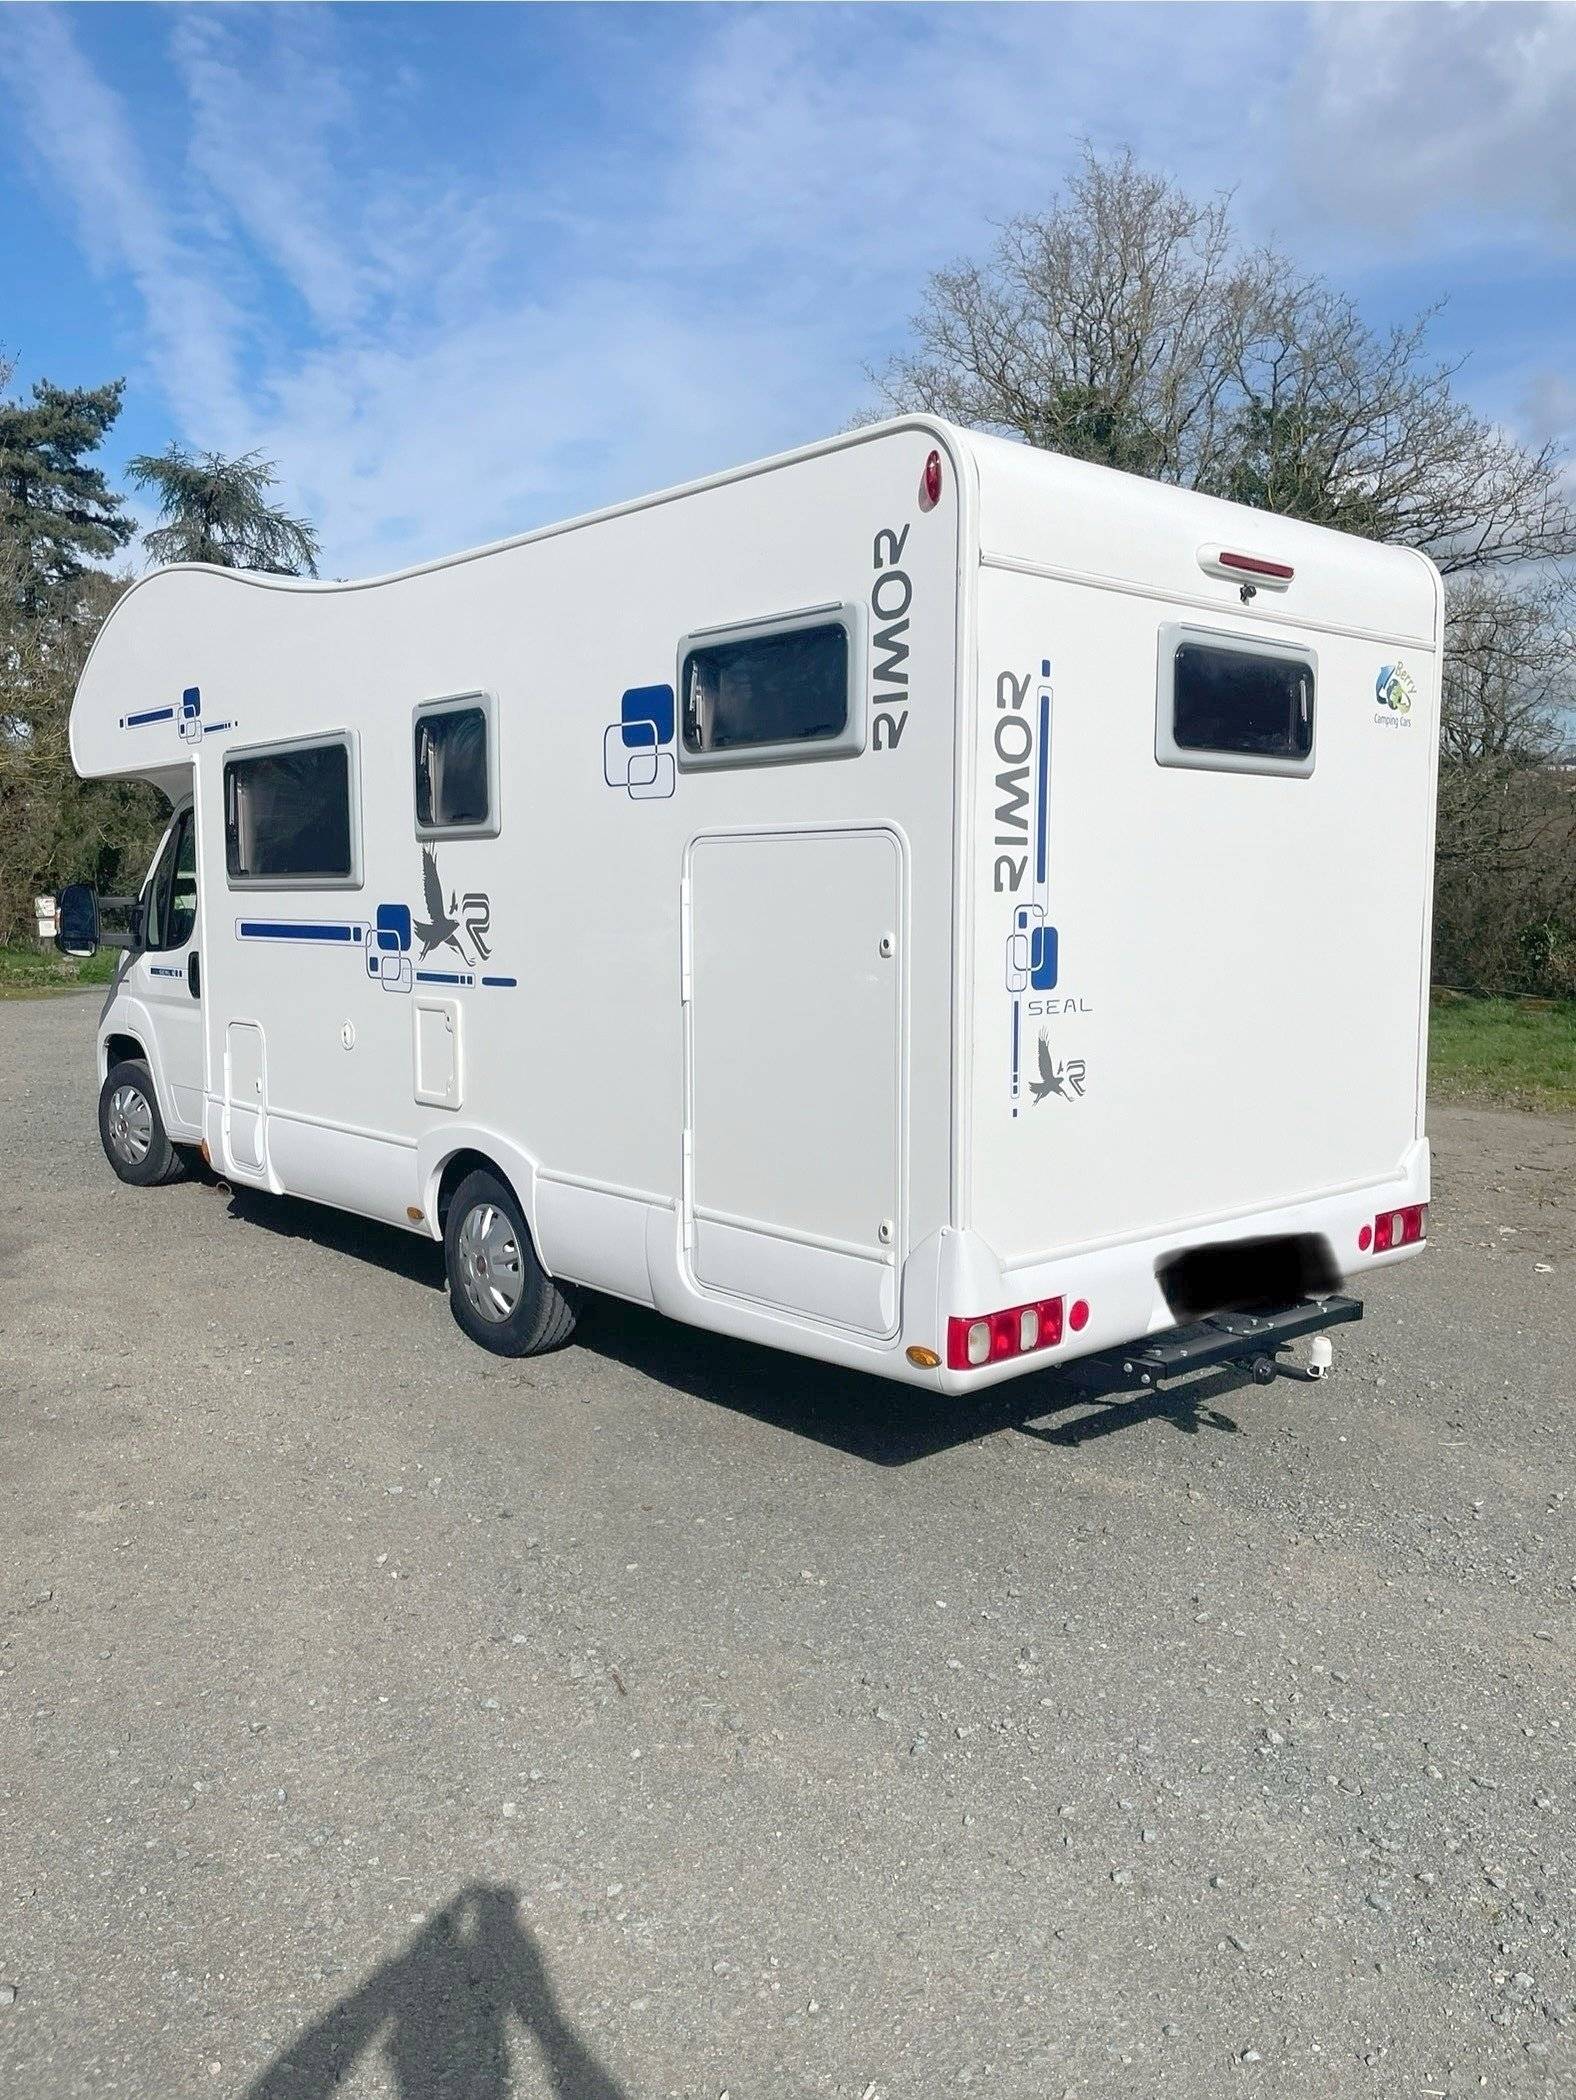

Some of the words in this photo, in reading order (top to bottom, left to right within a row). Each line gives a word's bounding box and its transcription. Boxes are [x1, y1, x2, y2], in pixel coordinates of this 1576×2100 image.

[872, 523, 912, 751] RIMOR
[1395, 661, 1417, 693] Berry
[1374, 713, 1398, 728] Camping
[1400, 716, 1411, 727] Cars
[994, 670, 1032, 892] RIMOR
[1028, 998, 1093, 1016] SEAL
